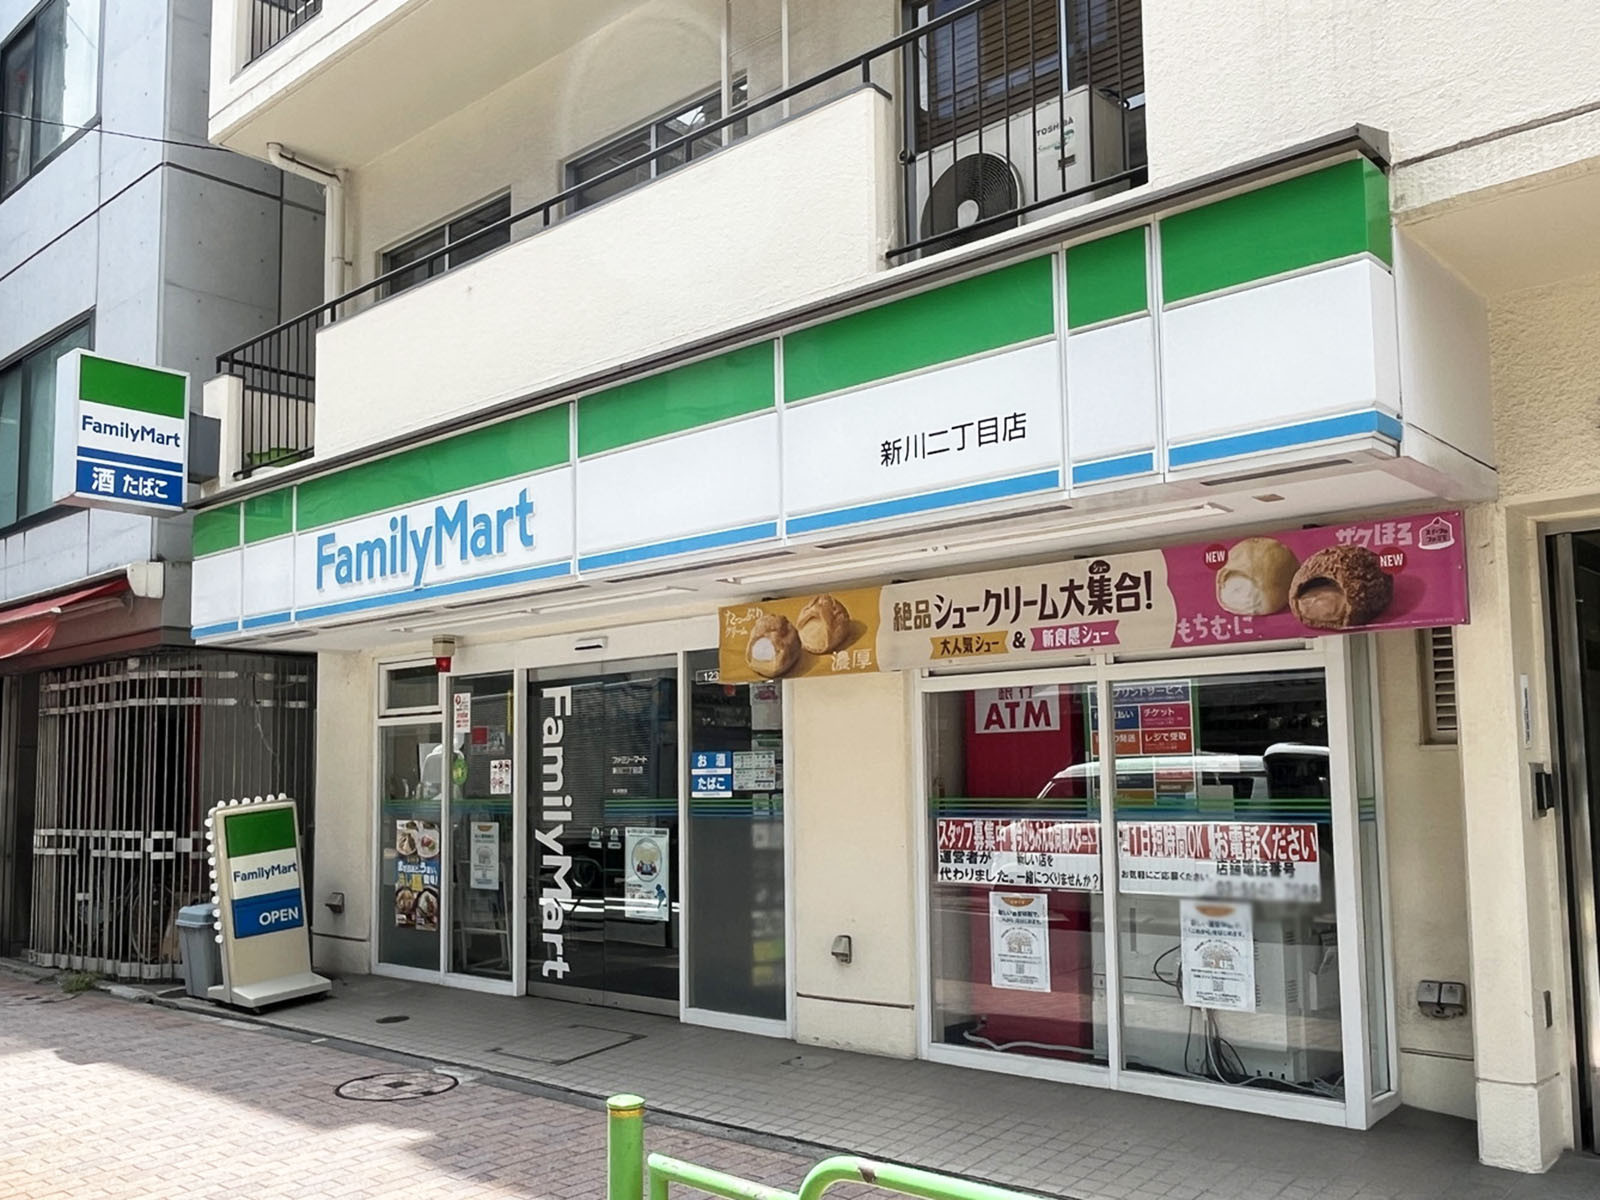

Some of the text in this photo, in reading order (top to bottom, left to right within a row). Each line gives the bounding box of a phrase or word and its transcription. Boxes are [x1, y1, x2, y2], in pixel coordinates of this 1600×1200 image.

[1036, 116, 1074, 136] TOSHBA
[82, 414, 181, 448] FamilyMart
[880, 412, 1027, 467] 新川二丁目店
[91, 466, 169, 499] 酒 たばこ
[316, 487, 534, 591] FamilyMart
[1335, 521, 1413, 547] ザクほろ
[1205, 551, 1226, 563] NEW
[1379, 553, 1404, 567] NEW
[1177, 613, 1253, 643] もちむに
[940, 625, 1110, 655] 大人気シュー & 新食感シュー
[831, 648, 872, 671] 濃厚
[703, 671, 720, 682] 123
[983, 699, 1052, 731] ATM
[1144, 708, 1175, 718] チケット
[1145, 731, 1187, 742] レジで受取
[697, 777, 726, 790] たばこ
[535, 686, 573, 979] FamilyMart
[233, 862, 298, 882] FamilyMart
[259, 907, 299, 926] OPEN
